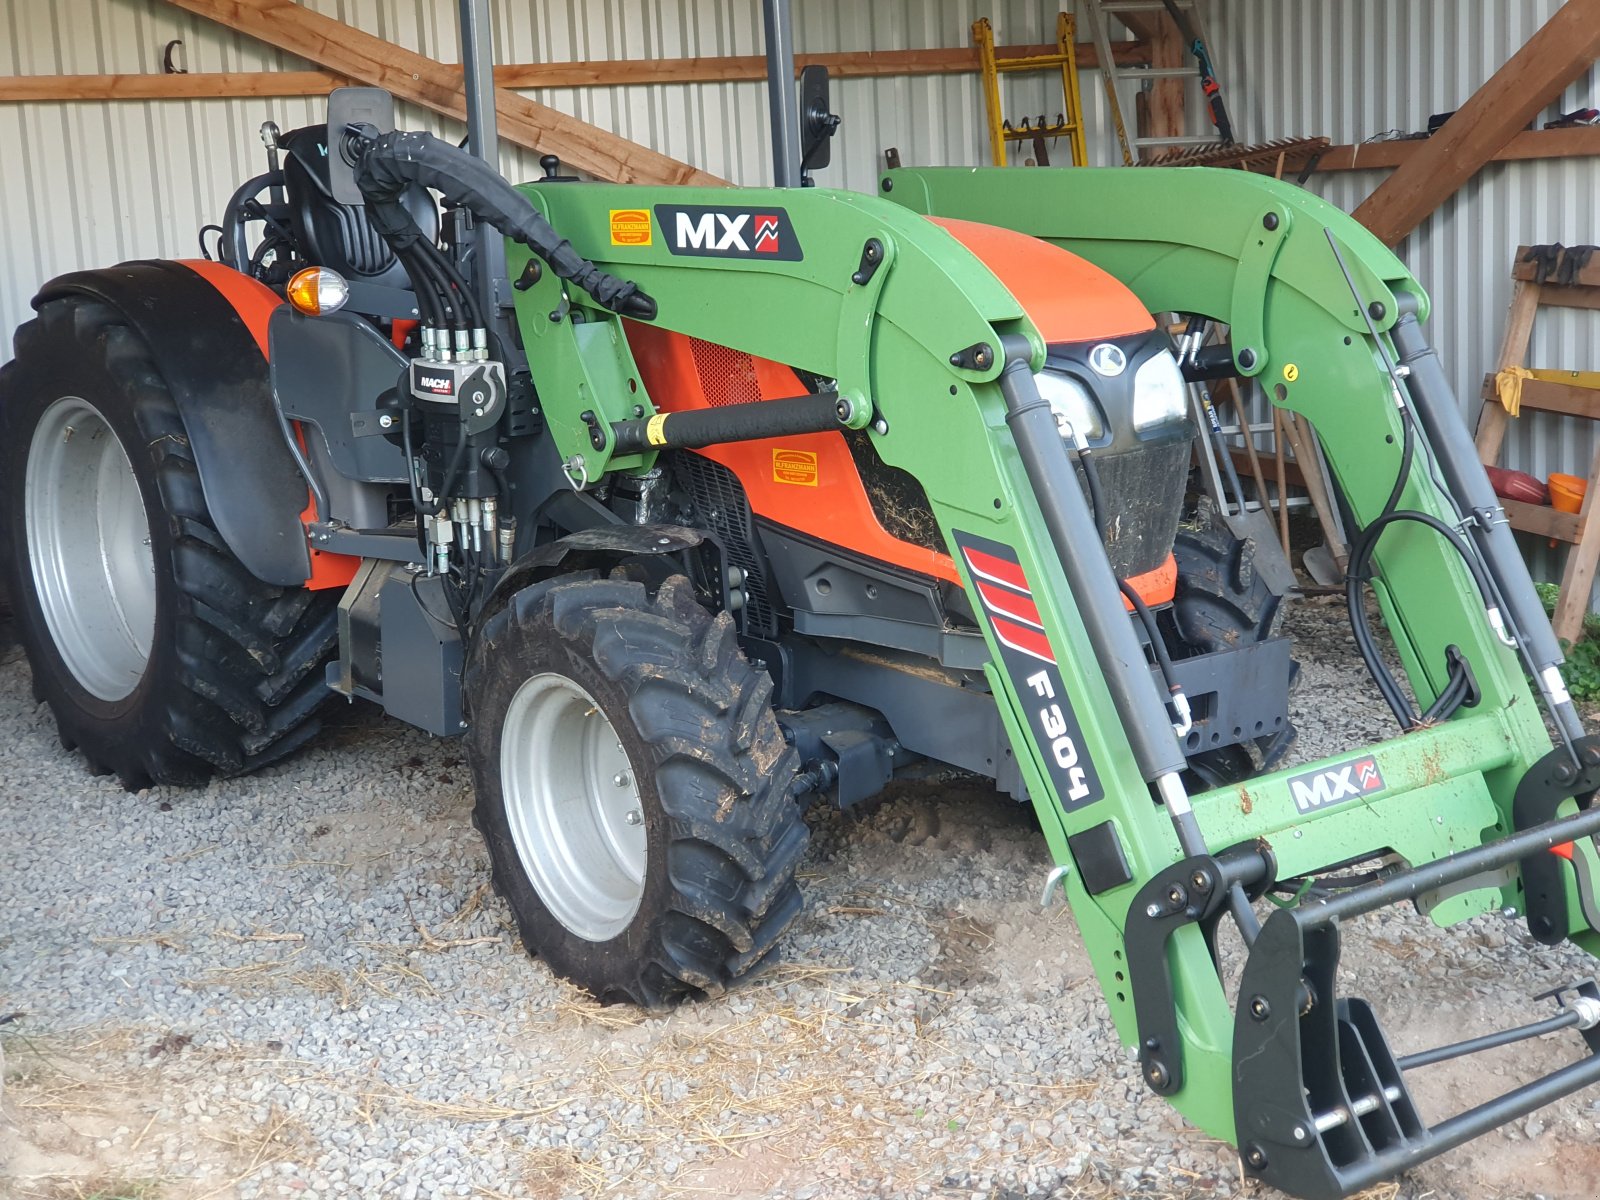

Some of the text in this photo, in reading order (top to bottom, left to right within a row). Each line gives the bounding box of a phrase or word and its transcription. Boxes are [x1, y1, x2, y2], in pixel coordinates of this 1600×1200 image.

[676, 212, 750, 251] MX
[421, 376, 450, 389] MACH
[1026, 670, 1091, 802] F 304
[1291, 765, 1361, 810] MX
